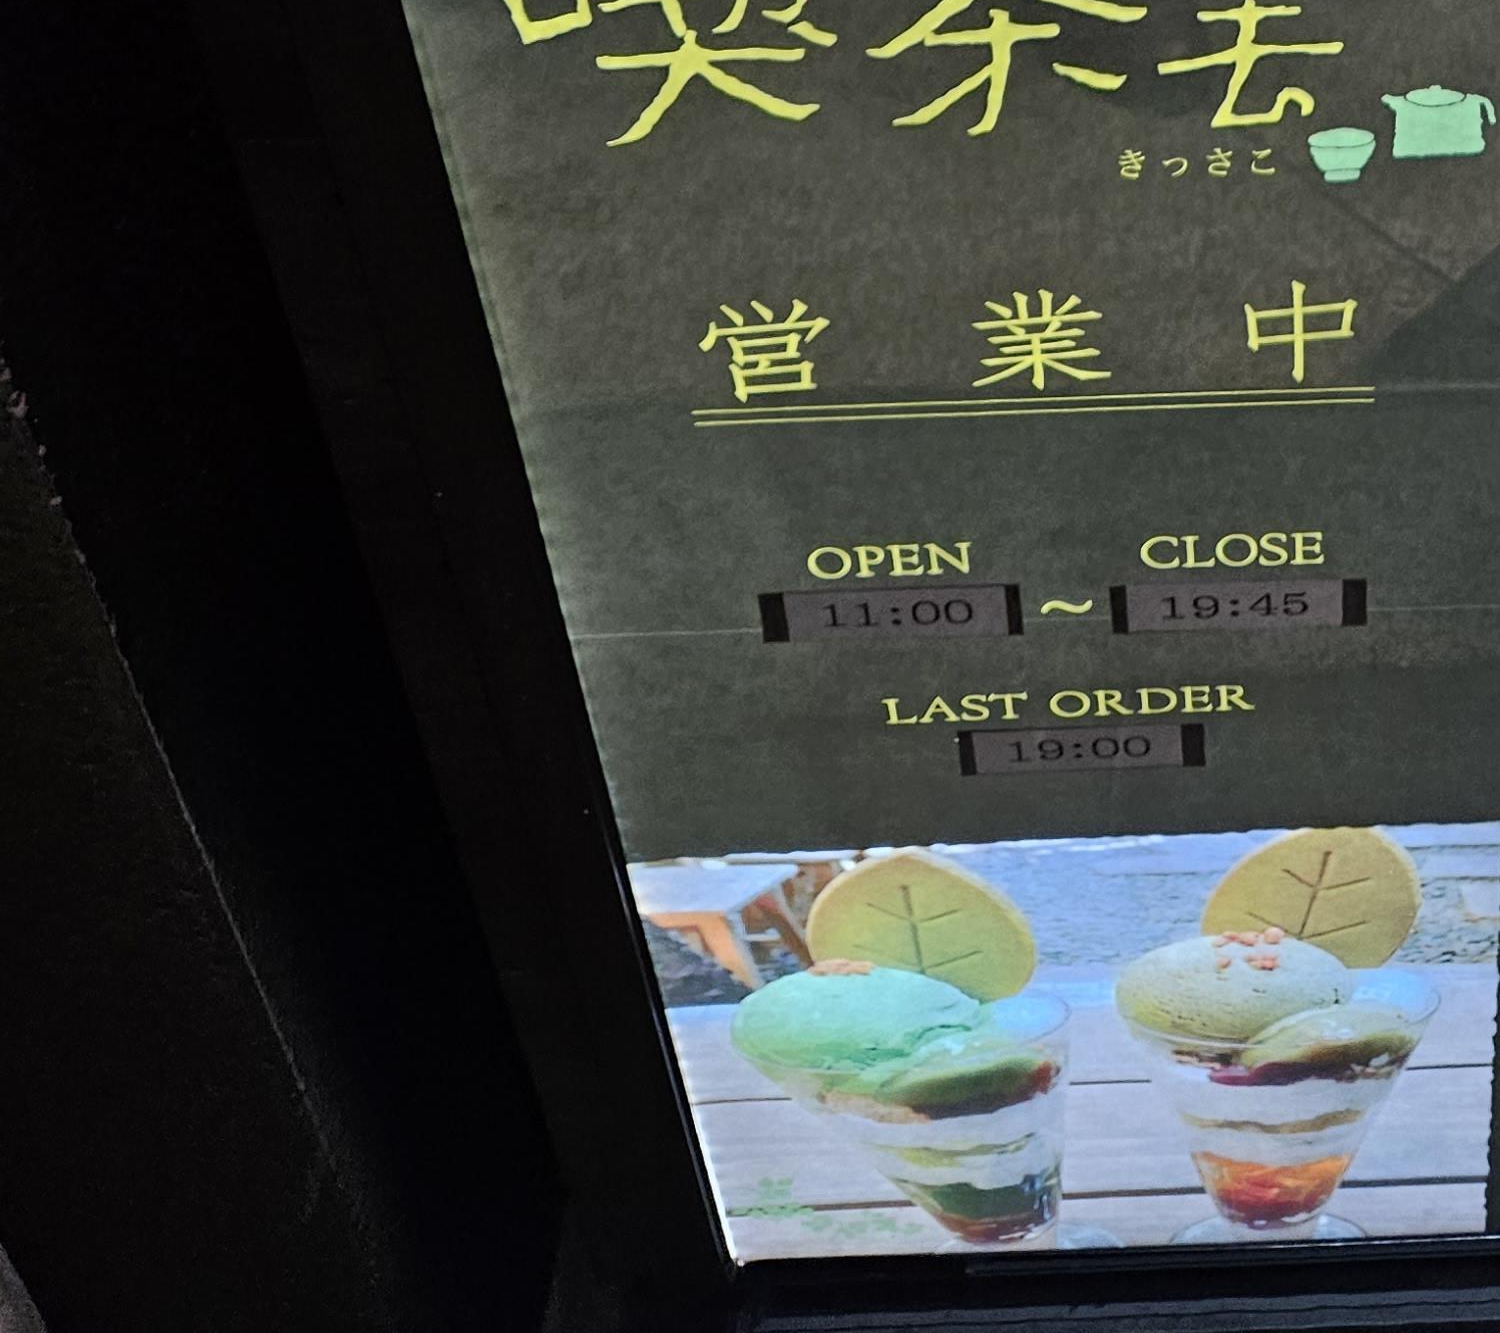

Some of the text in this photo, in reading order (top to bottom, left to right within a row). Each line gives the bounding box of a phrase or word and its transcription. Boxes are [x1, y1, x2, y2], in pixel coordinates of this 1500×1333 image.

[1118, 147, 1276, 180] きっさこ
[697, 279, 1358, 402] 営業中
[805, 531, 1326, 580] OPEN CLOSE
[821, 597, 975, 629] 11:00
[1160, 591, 1310, 623] 19:45
[881, 683, 1256, 726] LAST ORDER
[1006, 734, 1152, 765] 19:00
